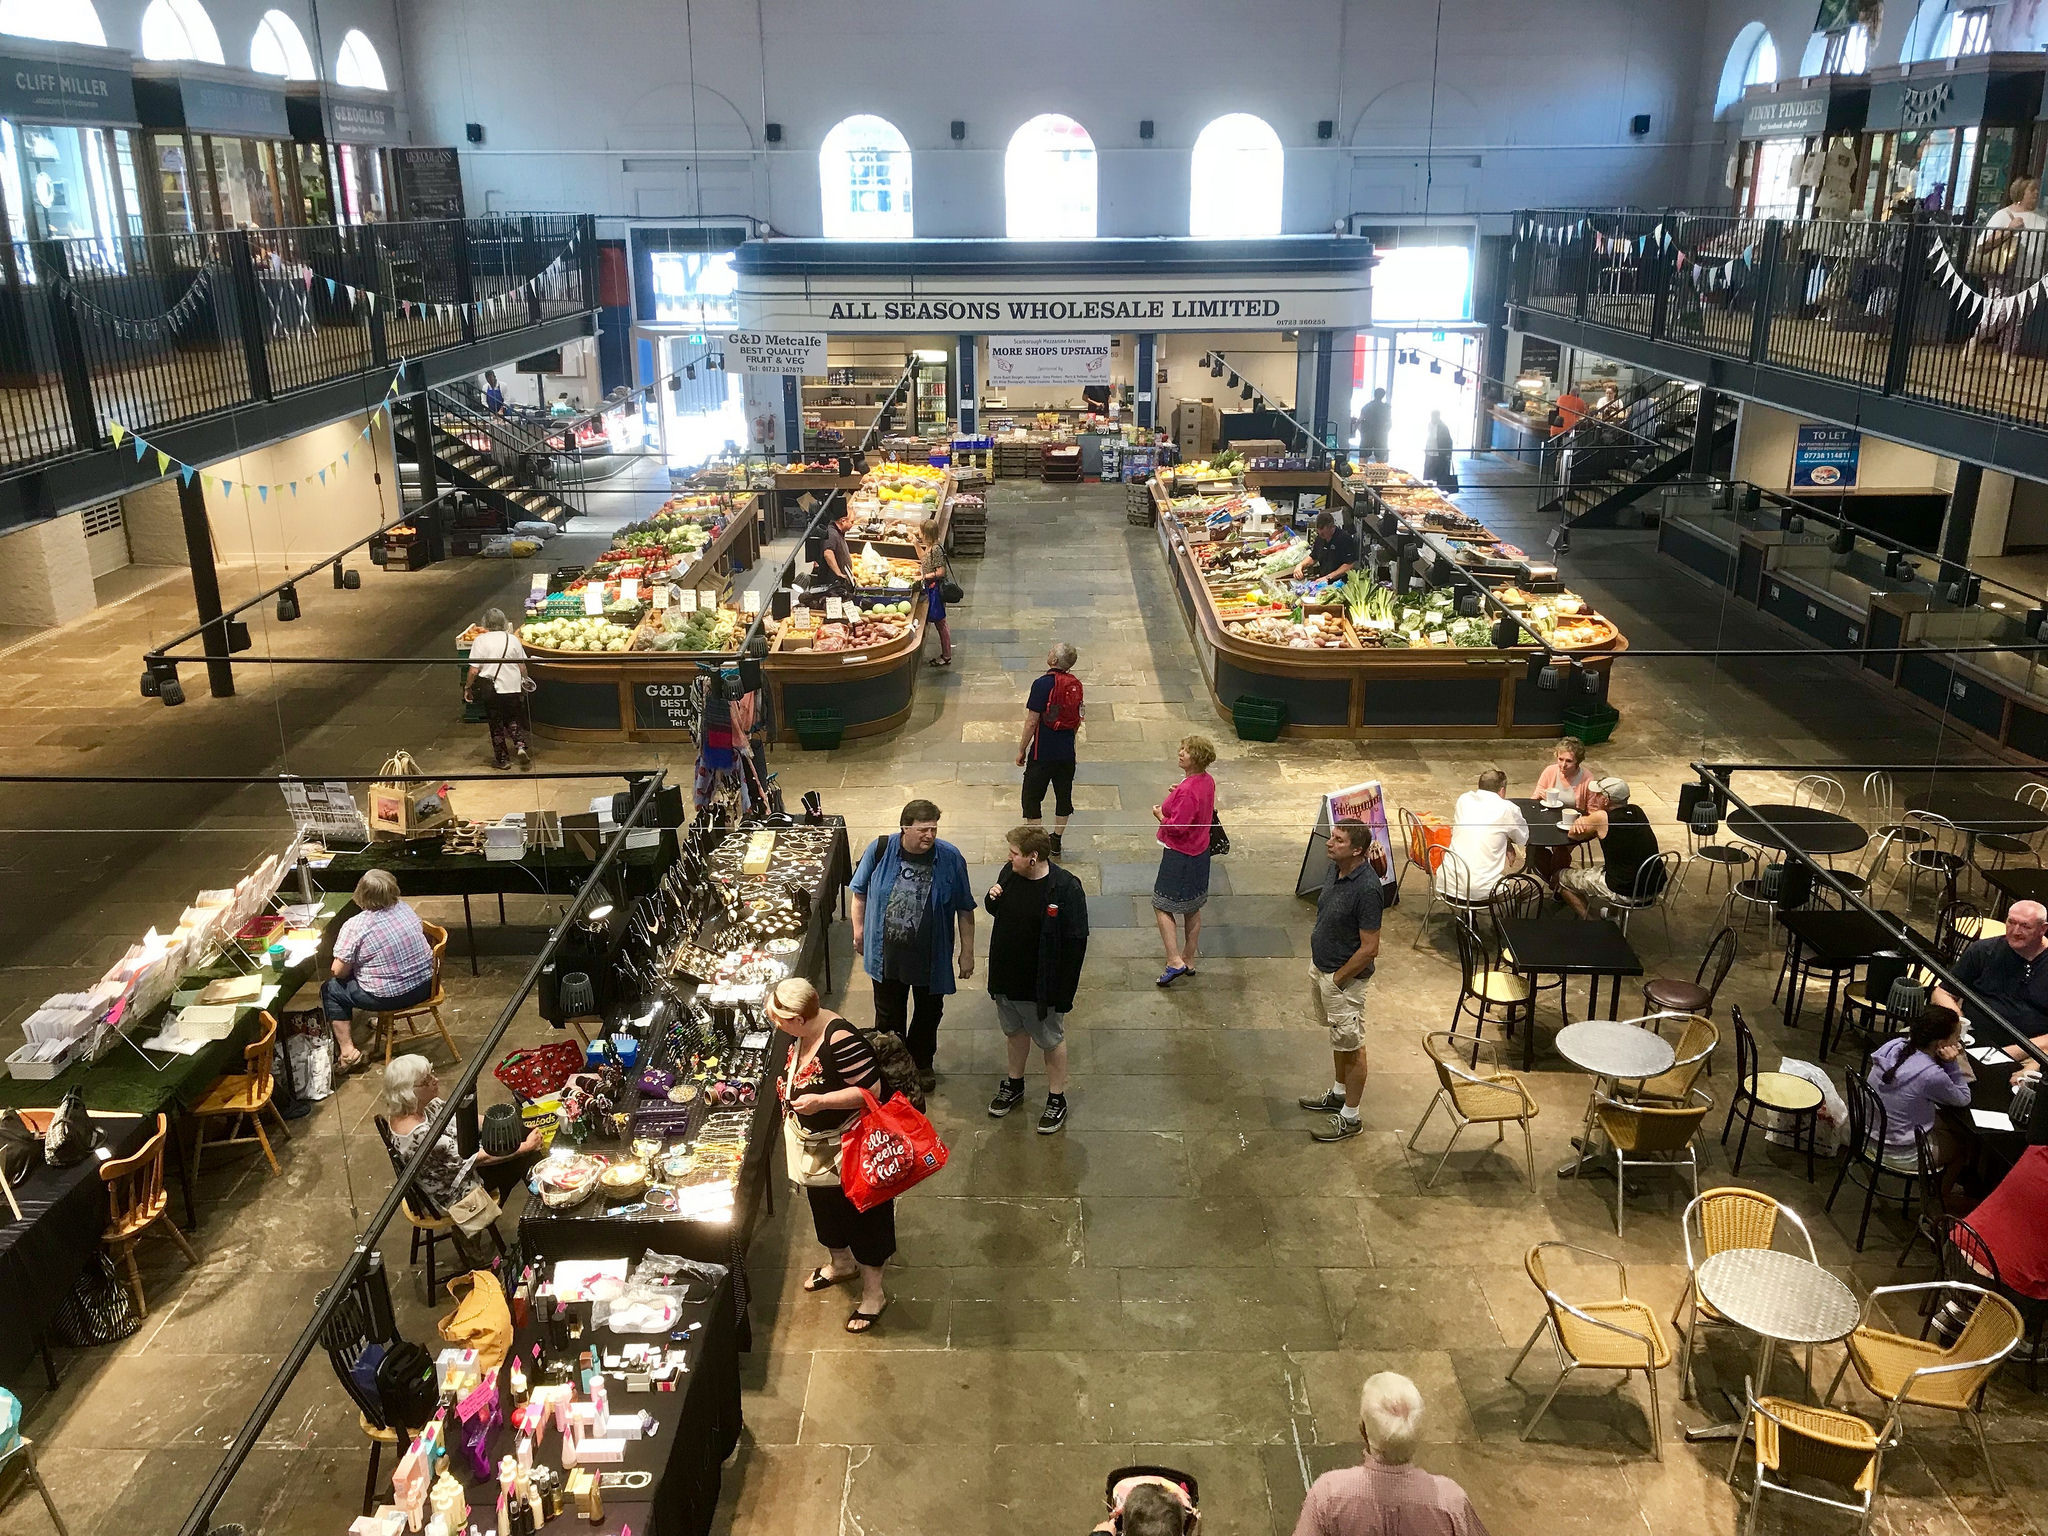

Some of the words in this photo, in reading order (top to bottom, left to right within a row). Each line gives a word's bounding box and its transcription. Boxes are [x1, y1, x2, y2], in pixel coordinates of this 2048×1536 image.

[16, 72, 55, 91] CLIFF
[59, 76, 109, 97] MILLER
[1748, 104, 1778, 121] JINNY
[1779, 99, 1824, 118] PINDERS
[829, 302, 876, 320] ALL
[885, 301, 1001, 320] SEASONS
[1007, 301, 1164, 320] WHOLESALE
[1171, 299, 1281, 318] LIMITED
[729, 333, 761, 345] G&D
[765, 334, 822, 347] Metcalfe
[740, 347, 763, 355] BEST
[766, 347, 810, 357] QUALITY
[992, 347, 1023, 356] MORE
[1025, 346, 1058, 356] SHOPS
[1060, 346, 1109, 356] UPSTAIRS
[746, 355, 773, 364] FRUIT
[775, 356, 783, 365] &
[785, 357, 805, 365] VEG
[1813, 431, 1827, 440] TO
[1828, 431, 1848, 440] LET
[645, 685, 685, 697] G&D
[660, 699, 689, 708] BEST
[667, 709, 691, 717] FRU
[670, 719, 686, 727] Tel:
[862, 1139, 905, 1177] Sweetie
[876, 1157, 901, 1180] Pie!
